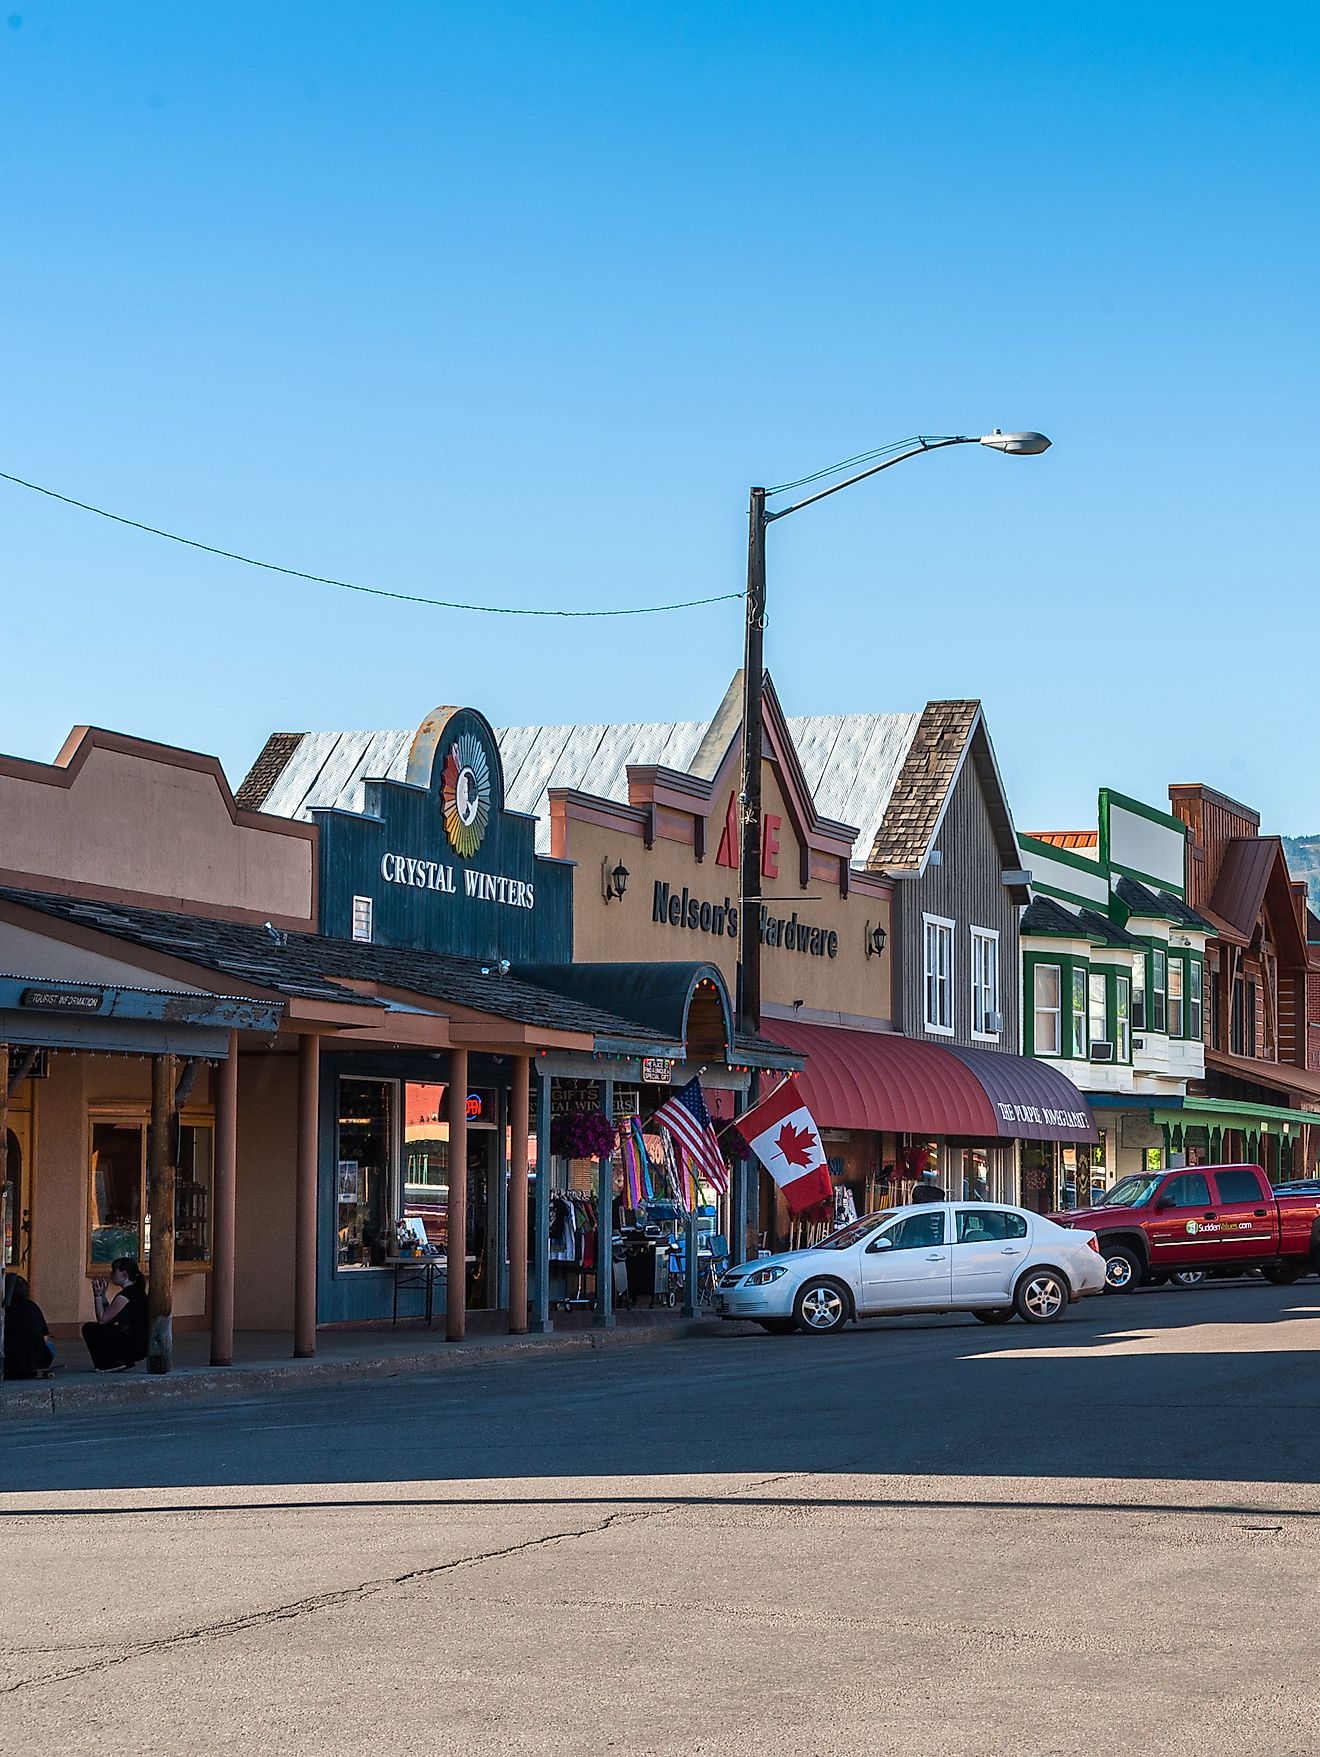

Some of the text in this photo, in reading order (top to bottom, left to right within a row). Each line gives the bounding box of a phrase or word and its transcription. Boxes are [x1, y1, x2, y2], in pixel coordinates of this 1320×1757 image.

[715, 790, 782, 879] AE
[381, 852, 534, 910] CRYSTAL WINTERS
[652, 880, 738, 938] Nelson's
[32, 992, 99, 1008] TOURIST INFORMATION
[552, 1089, 598, 1100] GIFTS
[997, 1102, 1015, 1121] THE
